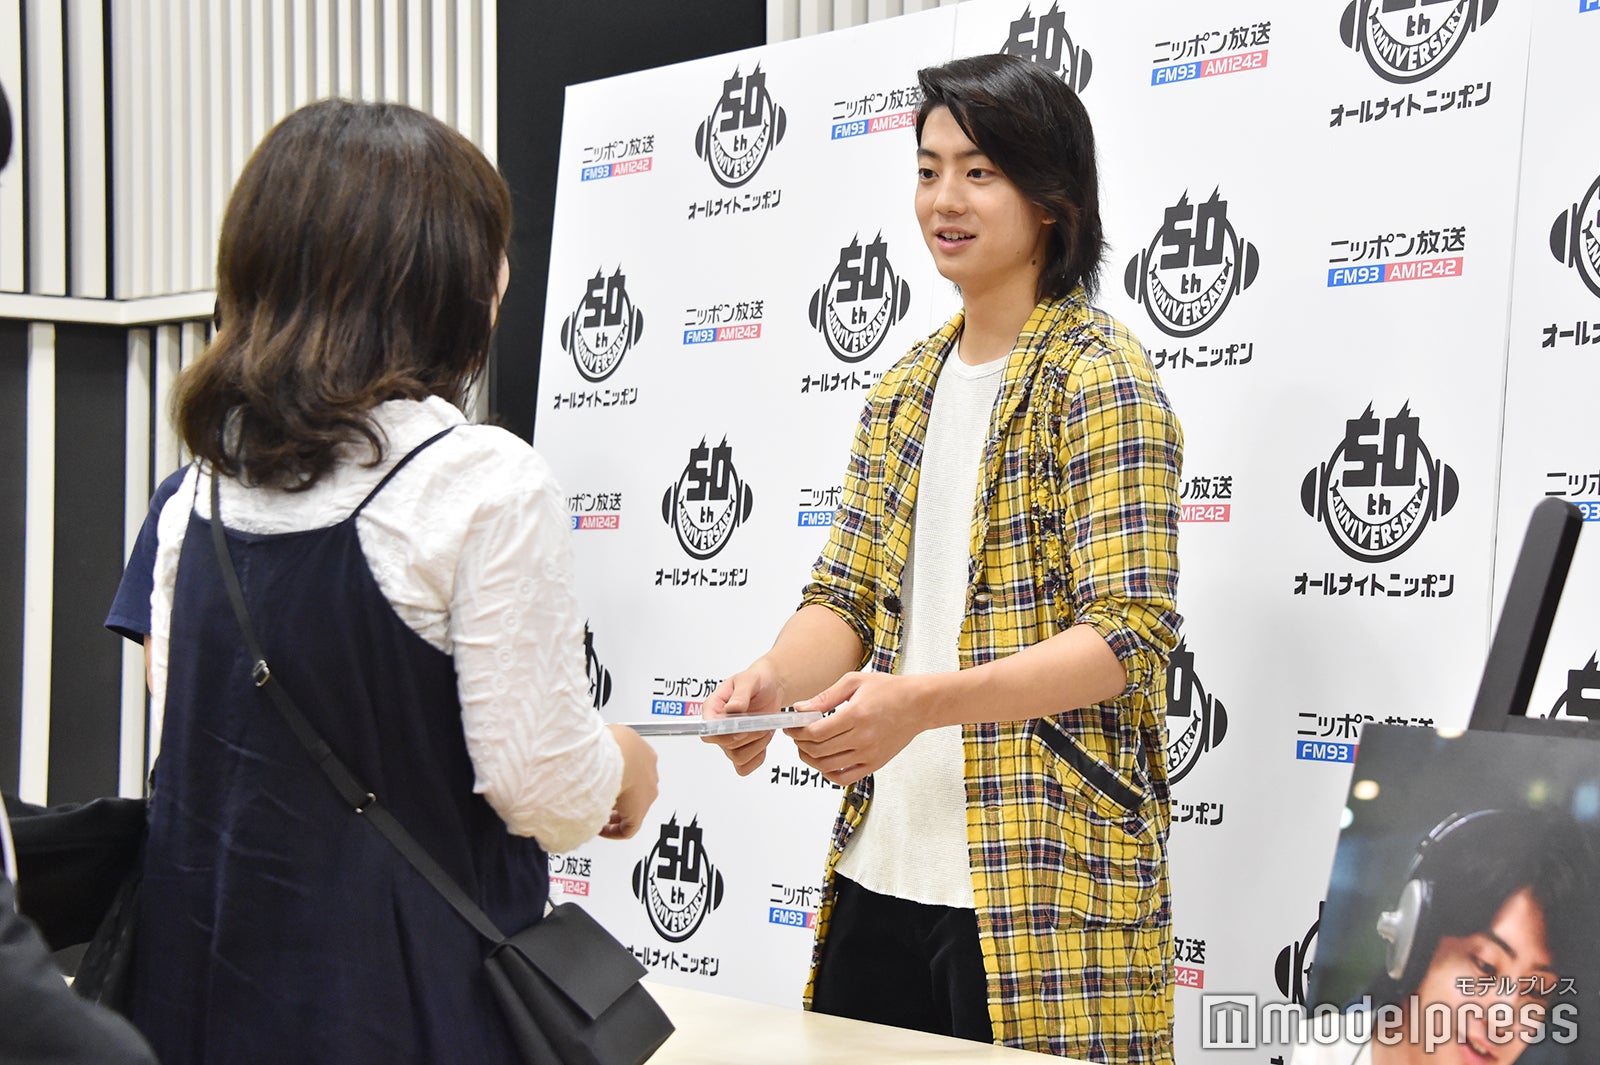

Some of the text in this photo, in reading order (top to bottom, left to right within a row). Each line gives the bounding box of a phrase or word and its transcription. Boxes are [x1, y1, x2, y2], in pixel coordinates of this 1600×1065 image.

[1406, 13, 1430, 37] th
[1153, 21, 1271, 64] ニッポン放送
[1371, 7, 1462, 71] ANNIVERSARY
[1156, 53, 1262, 83] FM93 AM1242
[720, 66, 767, 132] 50
[1330, 82, 1491, 127] オールナイトニッポン
[834, 121, 865, 138] FM93
[582, 135, 655, 164] ニッポン放送
[713, 132, 767, 178] ANNIVERSARY
[733, 135, 747, 152] th
[583, 159, 650, 180] FM93 AM1242
[688, 190, 781, 220] オールナイトニッポン
[1160, 192, 1228, 270] 50
[1329, 226, 1466, 264] ニッポン放送
[836, 236, 888, 302] 50
[1333, 260, 1456, 285] FM93 AM1242
[1181, 273, 1201, 294] th
[584, 269, 626, 328] 50
[1150, 271, 1230, 326] ANNIVERSARY
[685, 301, 764, 326] ニッポン放送
[828, 301, 889, 352] ANNIVERSARY
[852, 307, 867, 324] th
[595, 332, 608, 347] th
[686, 326, 758, 343] FM93 AM1242
[577, 329, 626, 373] ANNIVERSARY
[1148, 343, 1253, 369] ナイトニッポン
[554, 388, 638, 409] オールナイトニッポン
[1343, 408, 1419, 487] 50
[687, 440, 732, 501] 50
[700, 506, 714, 523] th
[1368, 493, 1391, 515] th
[581, 516, 616, 528] AM1242
[680, 503, 735, 550] ANNIVERSARY
[801, 513, 832, 525] FM93
[1332, 494, 1423, 549] ANNIVERSARY
[655, 568, 748, 587] オールナイトニッポン
[1294, 572, 1454, 598] オールナイトニッポン
[654, 701, 682, 714] FM93
[1302, 743, 1347, 760] FM93
[657, 817, 703, 883] 50
[671, 886, 684, 904] th
[650, 884, 704, 933] ANNIVERSARY
[772, 910, 803, 925] FM93
